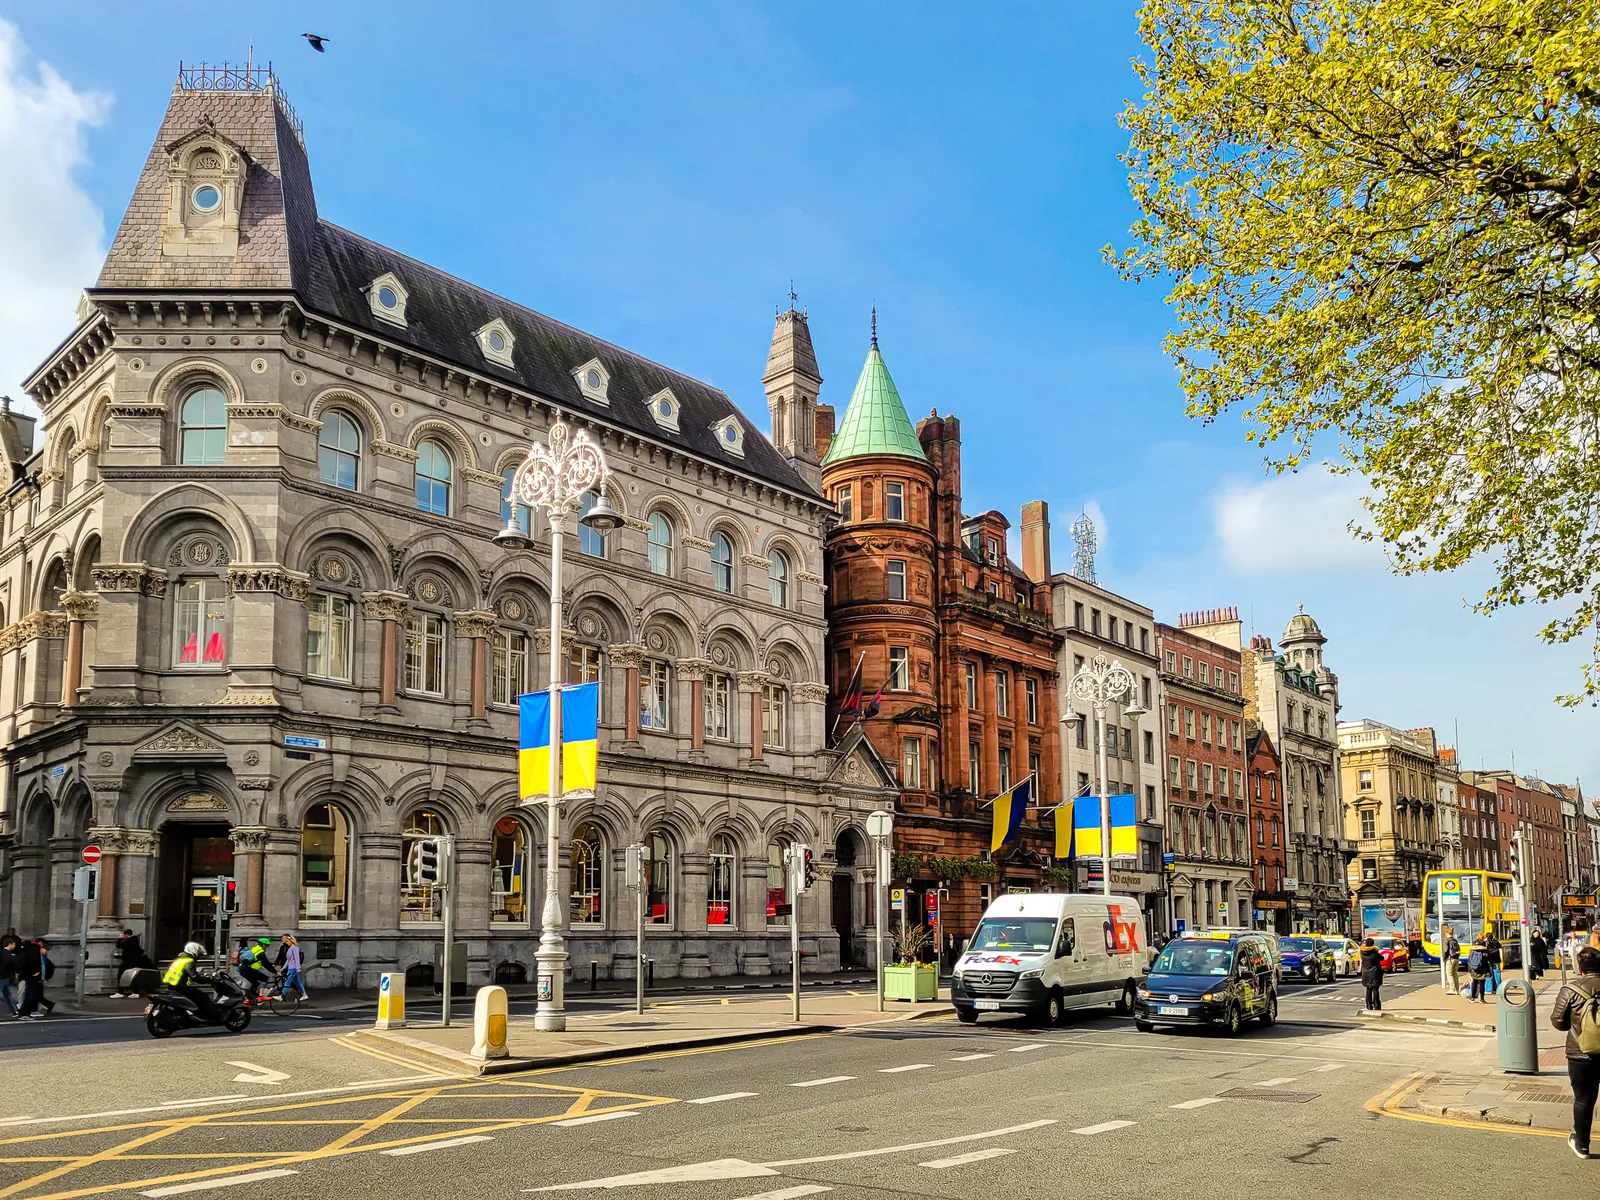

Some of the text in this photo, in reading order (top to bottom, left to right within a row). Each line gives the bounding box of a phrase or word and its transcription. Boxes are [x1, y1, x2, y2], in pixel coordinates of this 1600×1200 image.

[182, 632, 224, 663] HM
[1121, 875, 1142, 887] express
[964, 955, 1024, 966] FedEx
